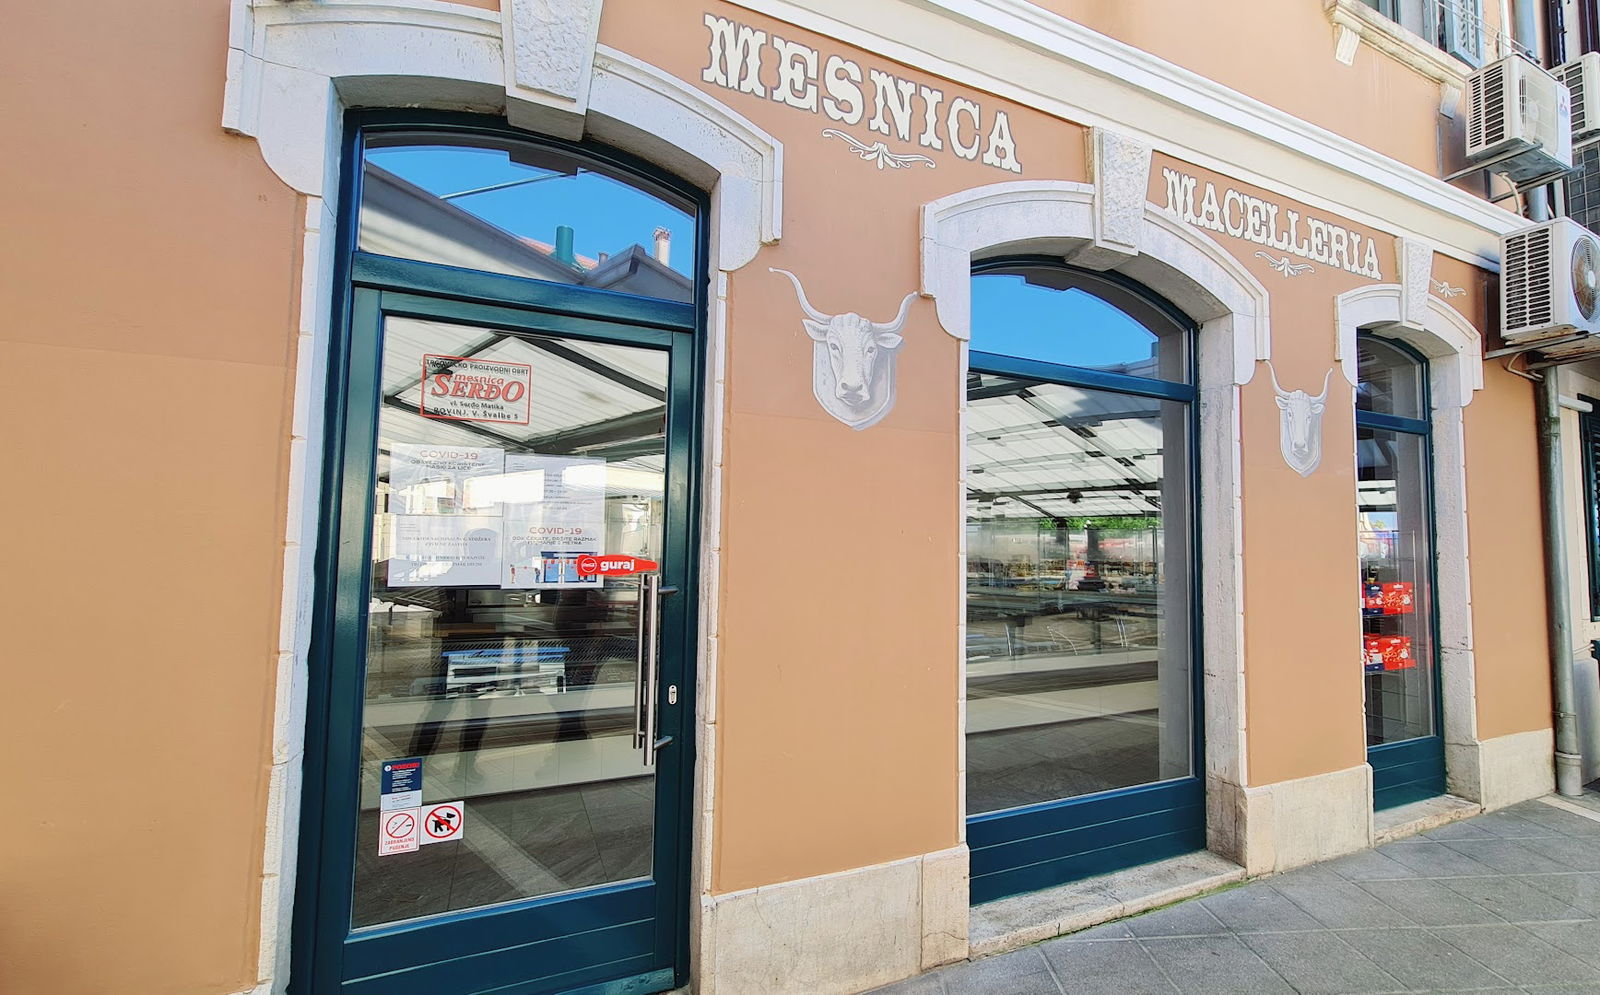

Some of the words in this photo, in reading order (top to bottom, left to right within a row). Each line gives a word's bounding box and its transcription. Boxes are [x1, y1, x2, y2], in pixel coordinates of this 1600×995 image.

[702, 12, 1022, 174] MESNICA
[1162, 166, 1382, 280] MACELLERIA
[454, 374, 504, 385] mesnica
[481, 402, 504, 410] Matika
[420, 450, 479, 460] COVID-19
[529, 527, 583, 535] COVID-19
[600, 559, 635, 571] guraj
